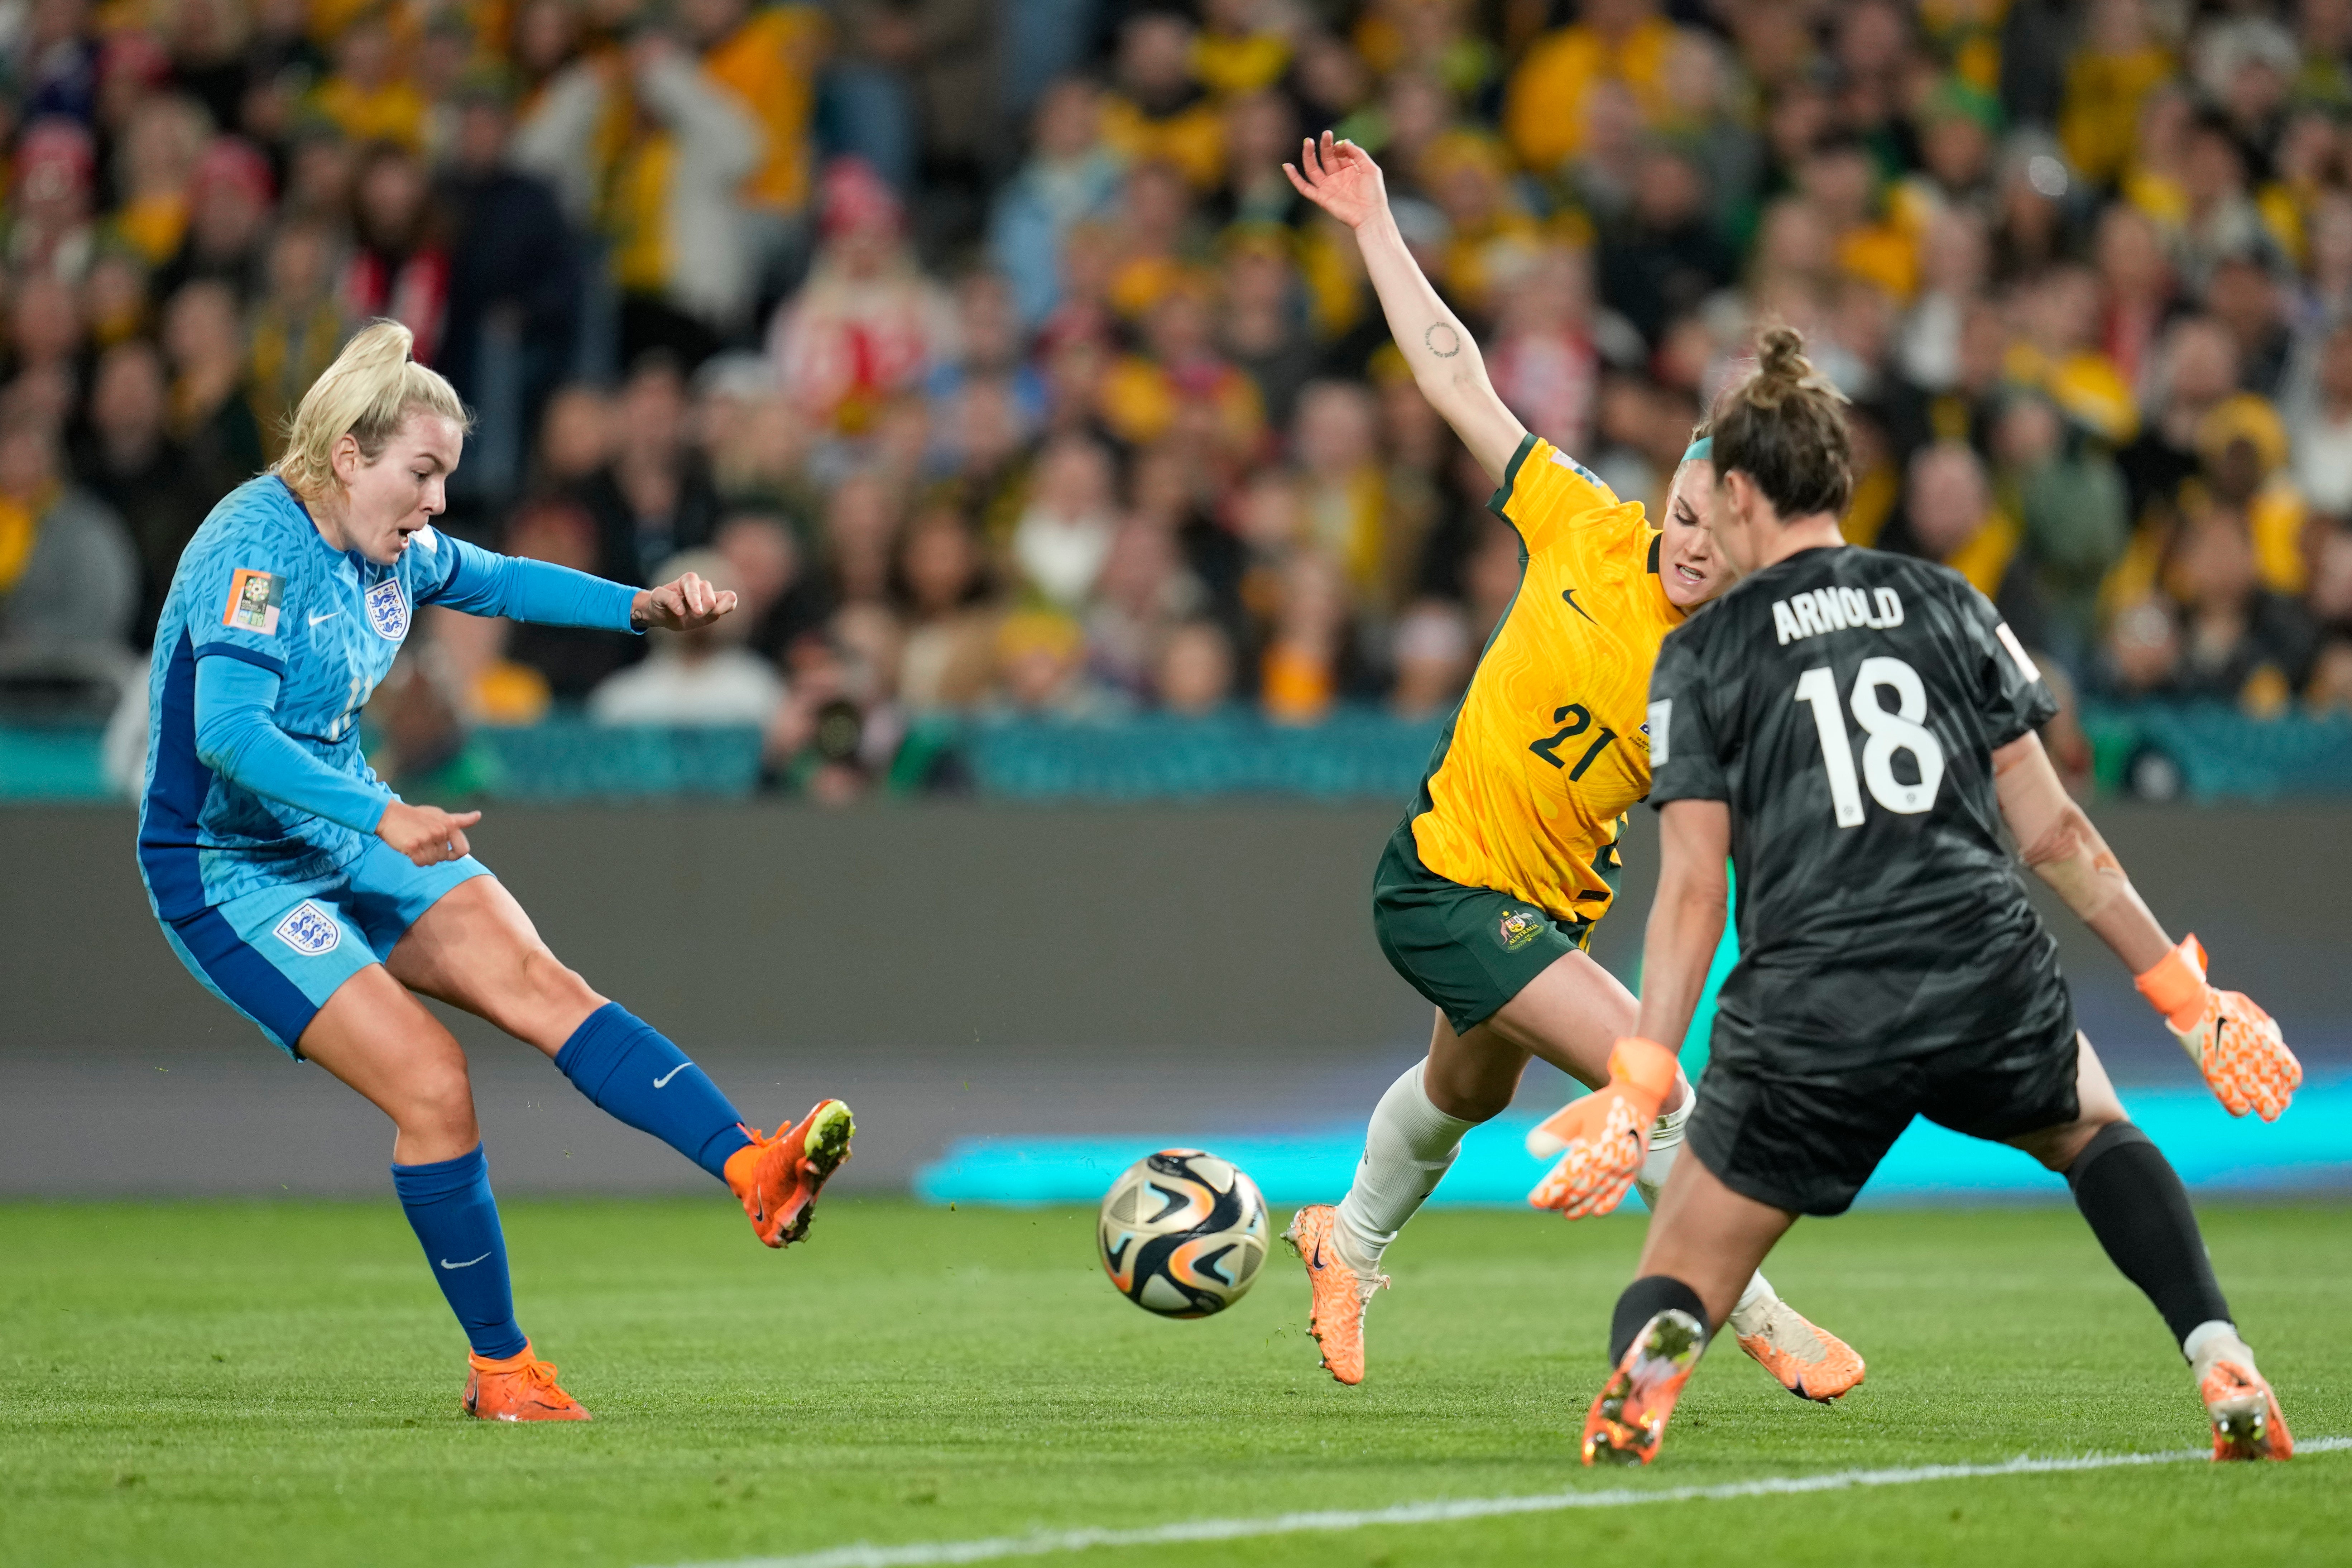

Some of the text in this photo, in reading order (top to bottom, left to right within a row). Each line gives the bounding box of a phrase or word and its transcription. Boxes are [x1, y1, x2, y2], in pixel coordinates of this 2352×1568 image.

[1772, 586, 1904, 645] ARNOLD
[1529, 703, 1618, 782] 21
[1795, 656, 1945, 828] 18
[1509, 924, 1539, 945] AUSTRALIA
